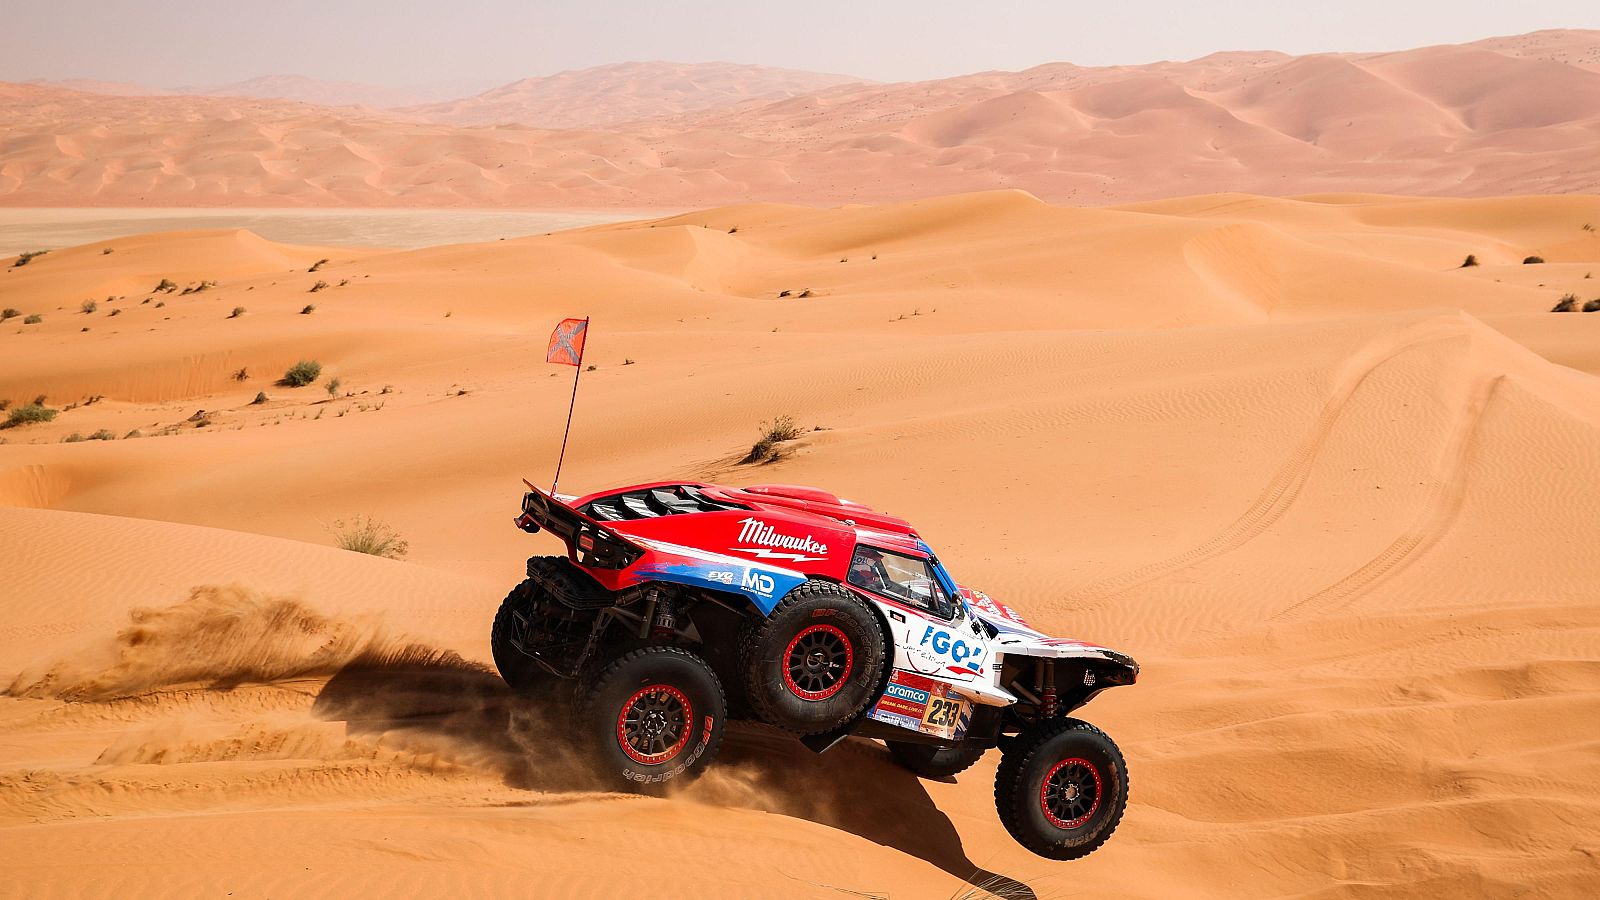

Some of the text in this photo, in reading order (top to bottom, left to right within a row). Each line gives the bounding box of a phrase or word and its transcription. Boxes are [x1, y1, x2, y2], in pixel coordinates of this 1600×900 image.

[737, 517, 828, 555] Milwaukee
[741, 566, 775, 594] MD
[887, 685, 925, 701] aramco
[926, 699, 960, 728] 233
[622, 715, 714, 784] BFGoodrich
